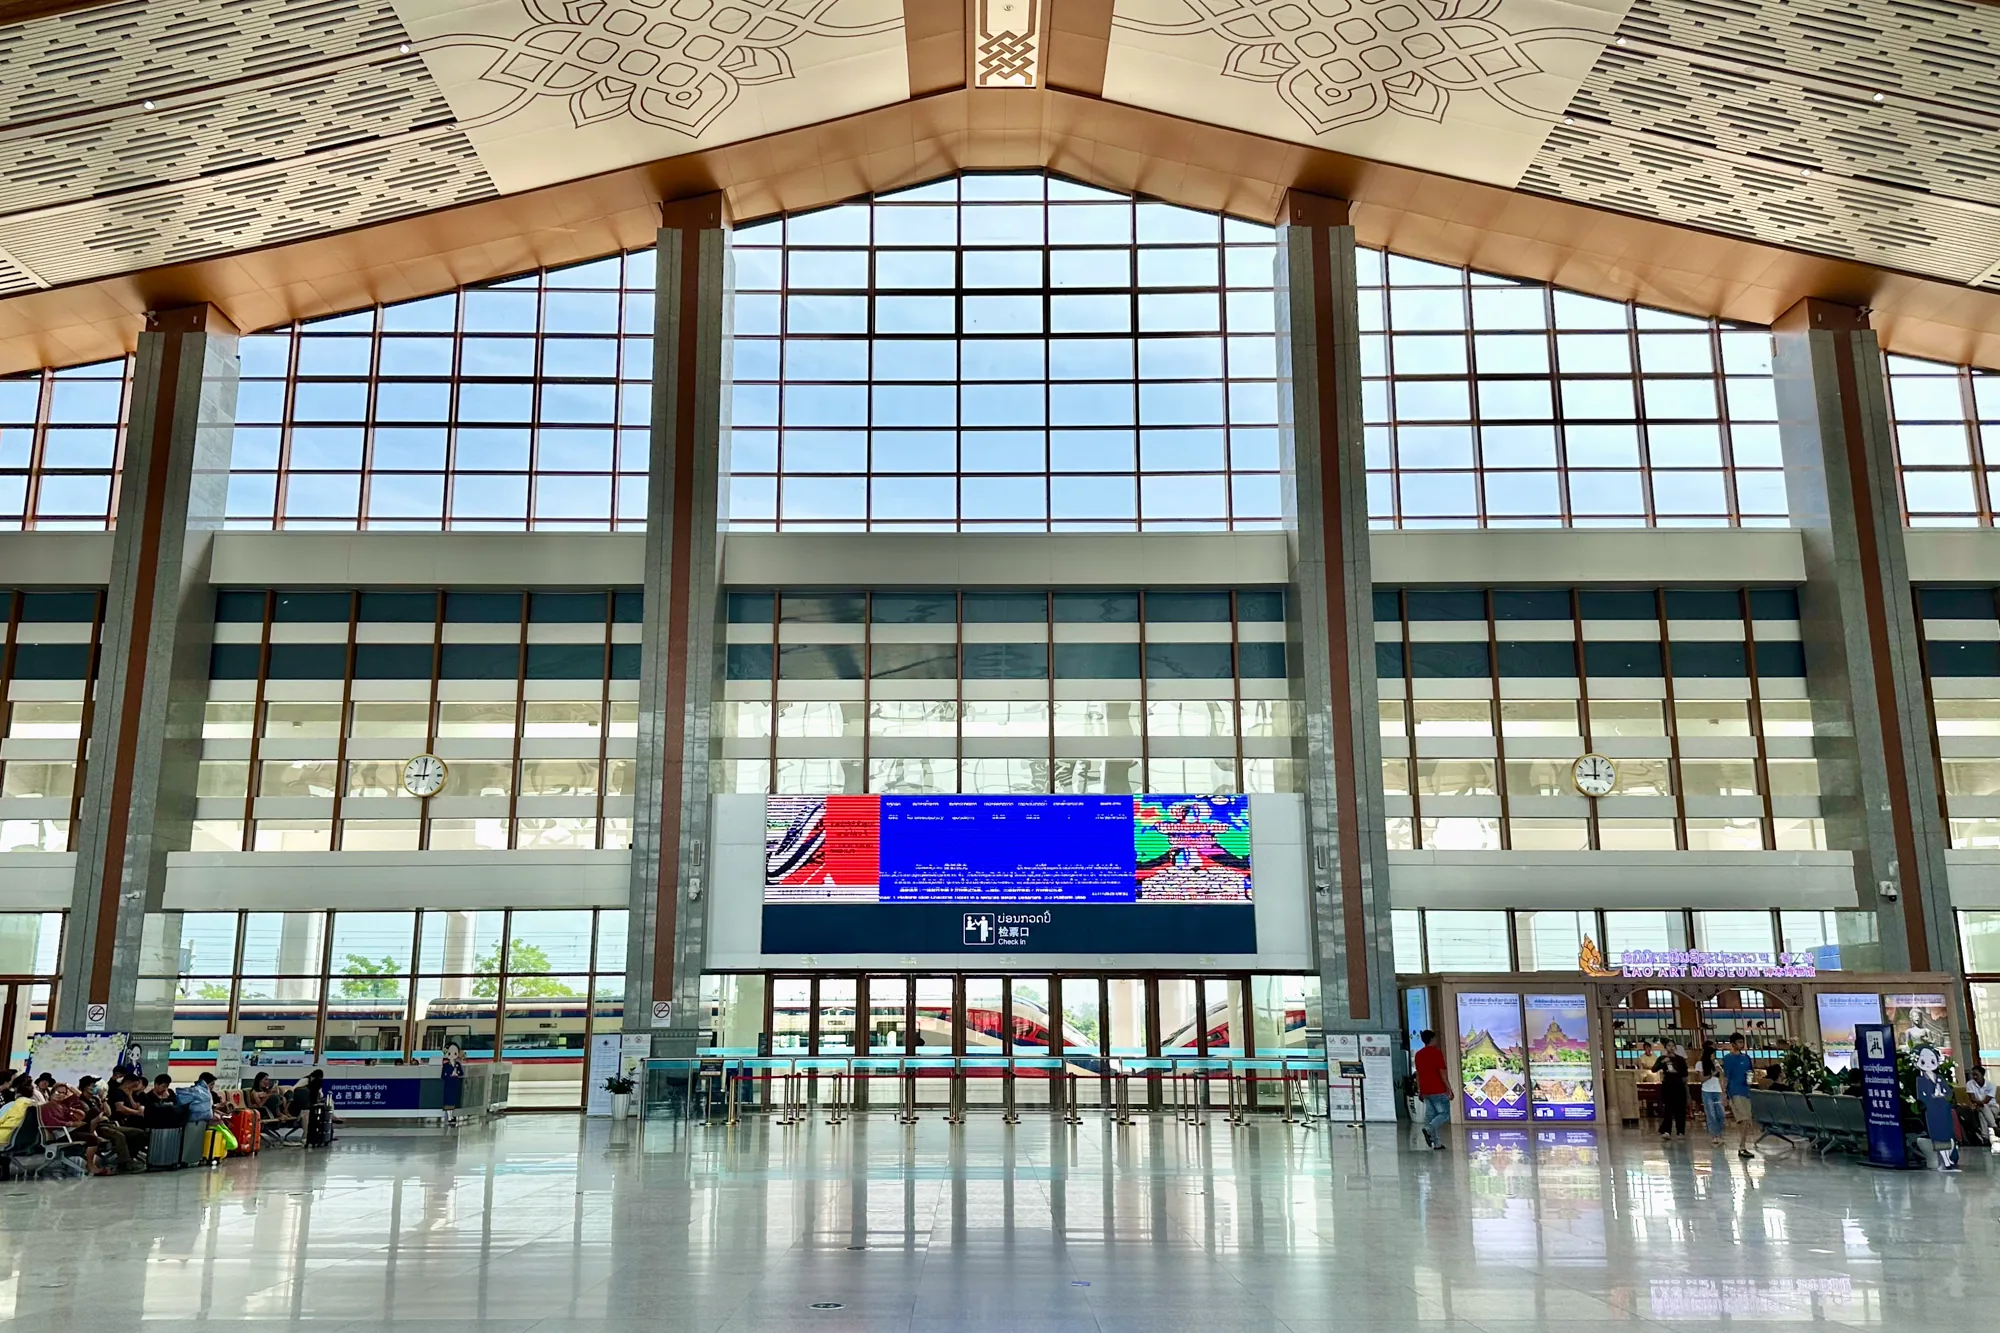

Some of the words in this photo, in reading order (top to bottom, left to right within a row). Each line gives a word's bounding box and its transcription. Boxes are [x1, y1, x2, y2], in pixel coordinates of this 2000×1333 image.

[998, 926, 1030, 938] 检票口
[1622, 965, 1653, 978] LAO
[1657, 965, 1687, 978] ART
[1691, 965, 1760, 978] MUSEUM
